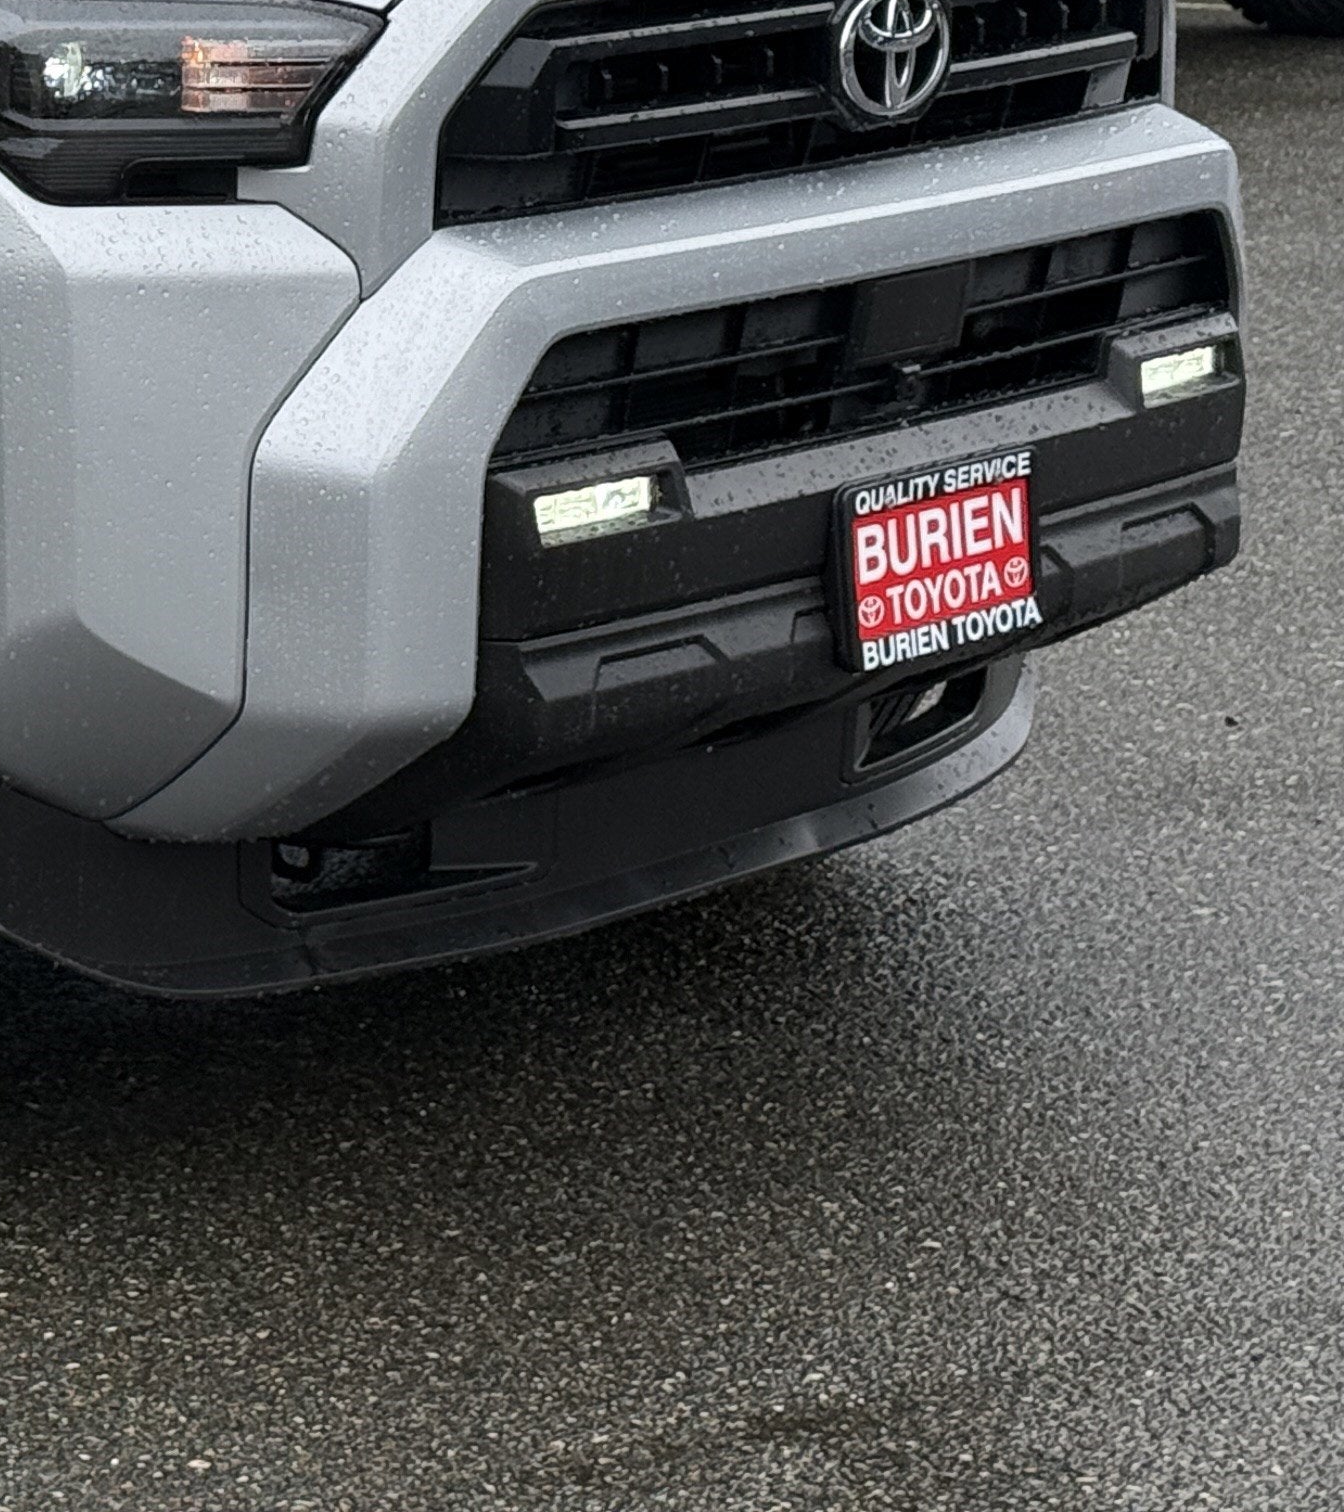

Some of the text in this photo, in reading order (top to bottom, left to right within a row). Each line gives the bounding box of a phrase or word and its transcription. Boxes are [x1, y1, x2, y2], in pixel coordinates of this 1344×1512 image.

[855, 451, 1032, 516] QUALITY SERVICE
[856, 487, 1024, 586] BURIEN
[885, 561, 1004, 625] TOYOTA
[862, 597, 1043, 672] BURIEN TOYOTA
